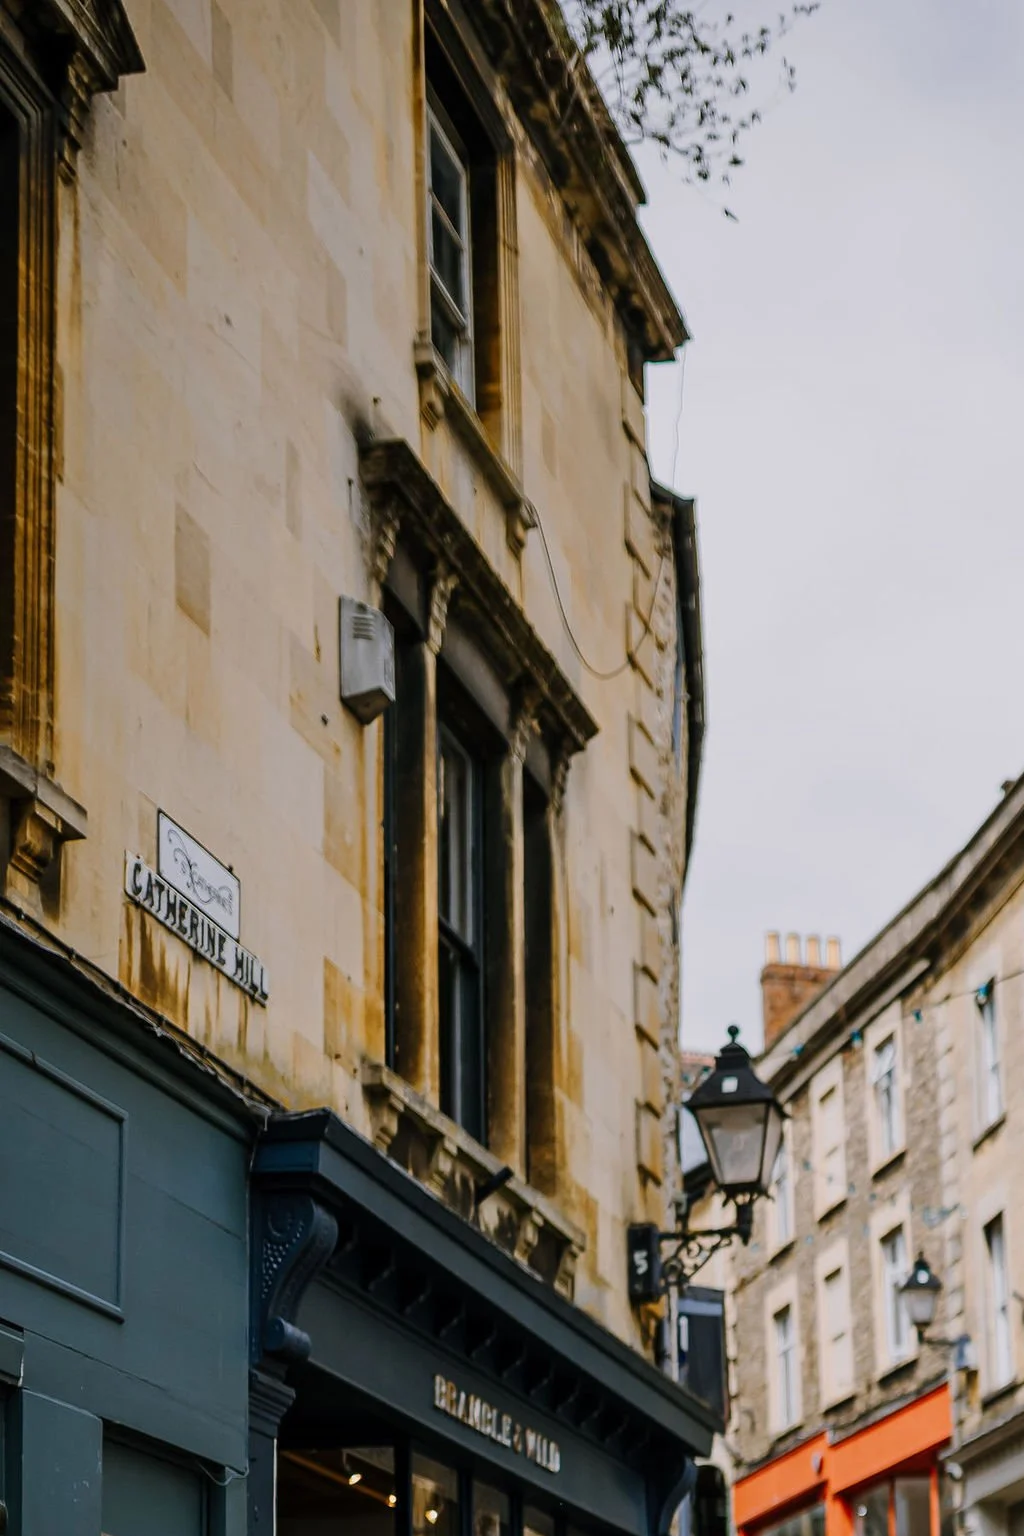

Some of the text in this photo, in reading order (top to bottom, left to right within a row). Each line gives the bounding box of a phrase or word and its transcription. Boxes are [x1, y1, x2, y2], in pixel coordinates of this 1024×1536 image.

[132, 863, 226, 966] CATHERINE
[233, 946, 268, 1001] HILL
[634, 1251, 648, 1275] 5
[525, 1428, 560, 1473] WILD
